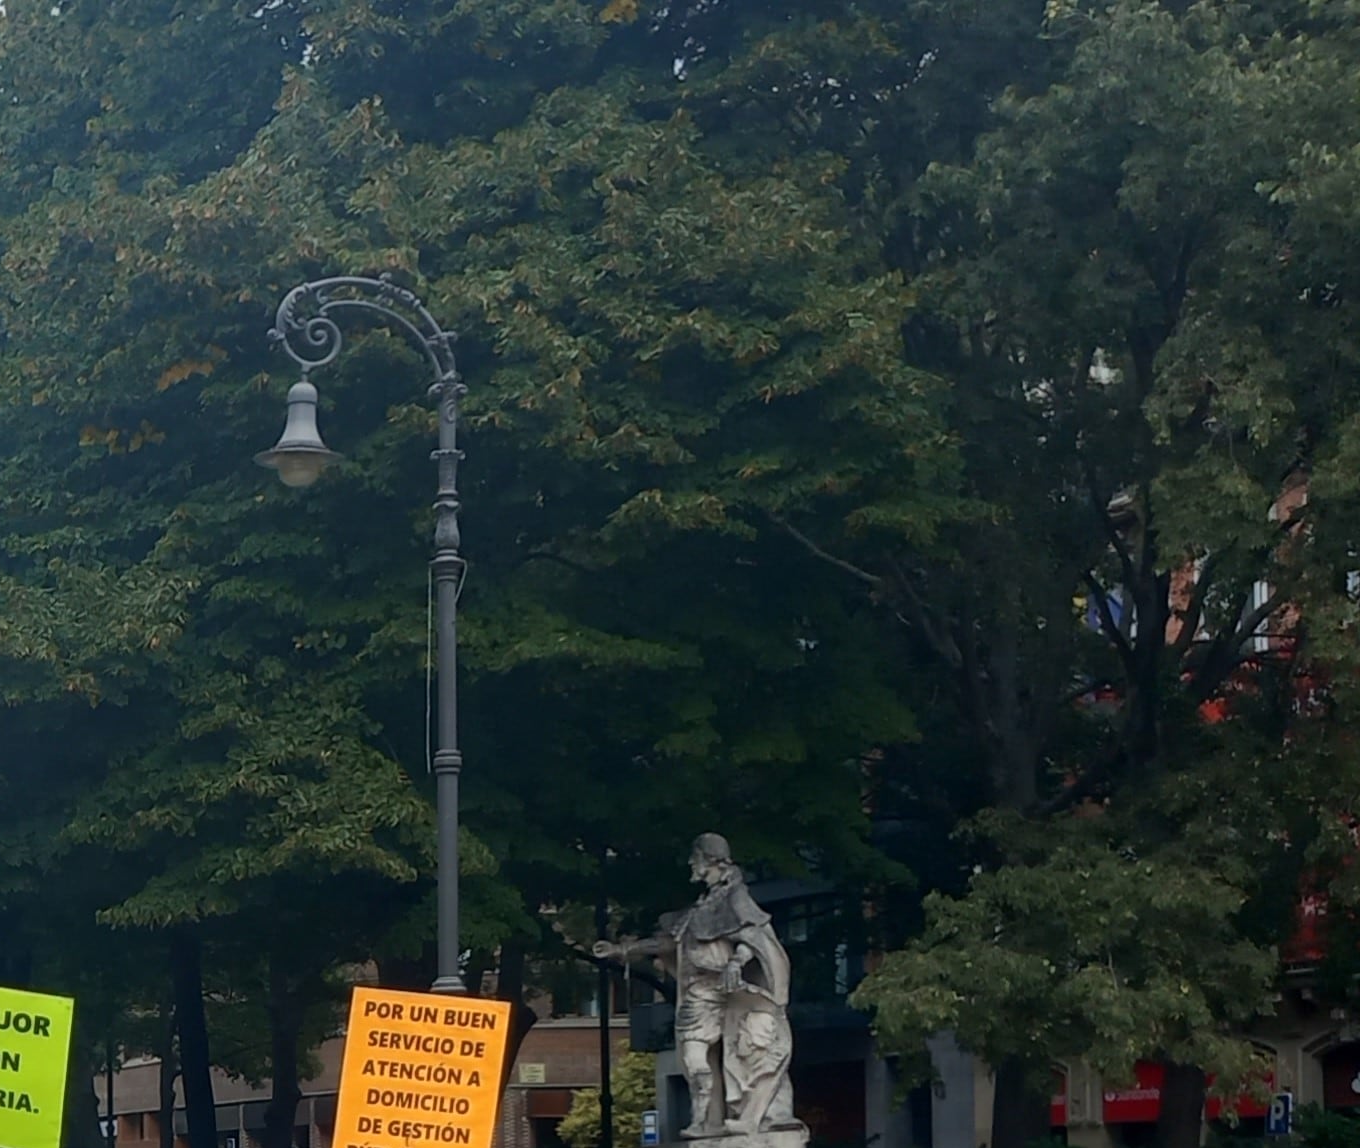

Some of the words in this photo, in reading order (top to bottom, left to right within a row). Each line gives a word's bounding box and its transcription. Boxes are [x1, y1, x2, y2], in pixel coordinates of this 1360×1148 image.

[364, 1001, 404, 1021] POR
[409, 1006, 439, 1024] UN
[443, 1009, 497, 1030] BUEN
[368, 1030, 454, 1054] SERVICIO
[460, 1040, 485, 1058] DE
[362, 1059, 462, 1085] ATENCIÓN
[467, 1071, 481, 1087] A
[366, 1089, 470, 1115] DOMICILIO
[358, 1117, 383, 1134] DE
[387, 1120, 470, 1144] GESTIÓN
